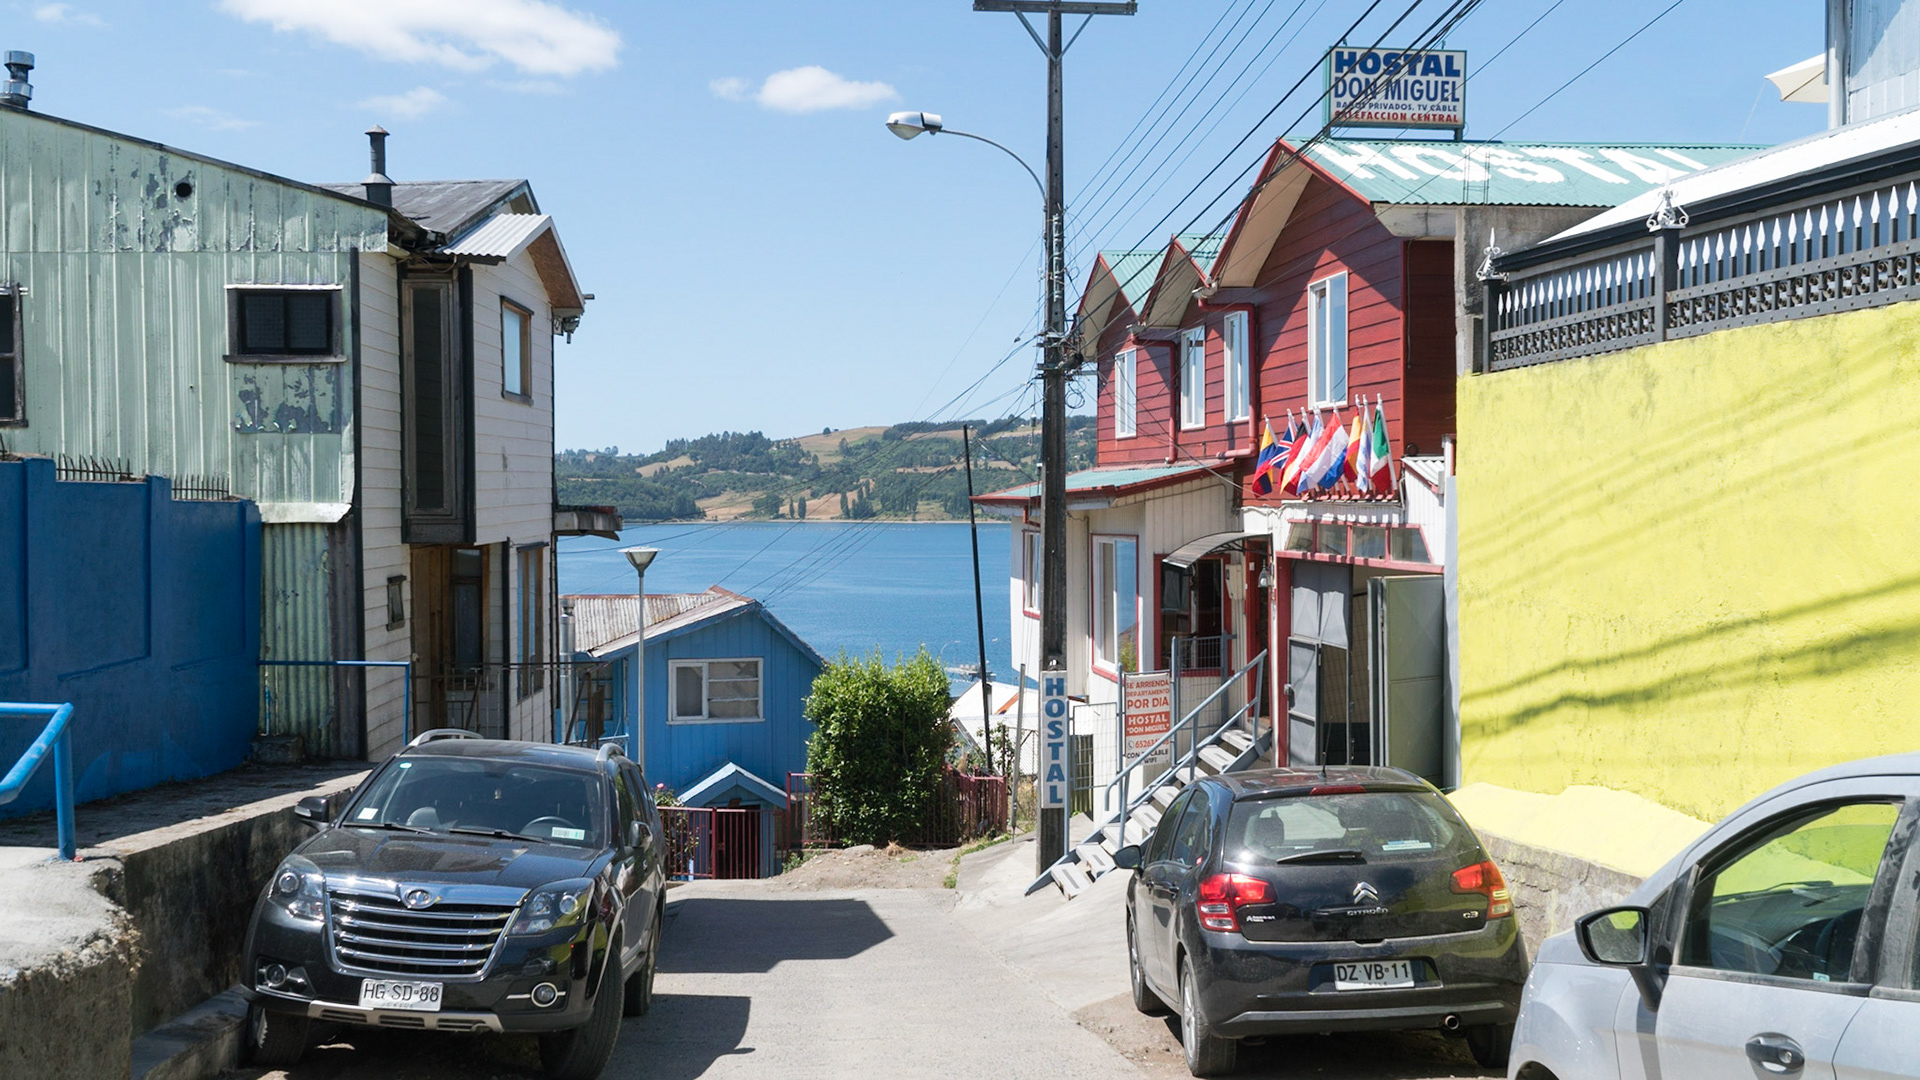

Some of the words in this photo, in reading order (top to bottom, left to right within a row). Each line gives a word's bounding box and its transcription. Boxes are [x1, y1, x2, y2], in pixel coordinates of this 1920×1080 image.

[1335, 51, 1460, 77] HOSTAL
[1334, 77, 1378, 100] DON
[1385, 79, 1460, 102] MIGUEL
[1336, 101, 1366, 110] BAOS
[1411, 113, 1458, 123] CENTRAL
[1135, 680, 1169, 688] ARRIENDA
[1127, 698, 1149, 709] POR
[1152, 696, 1169, 708] DIA
[1128, 714, 1168, 726] HOSTAL
[1045, 678, 1066, 804] HOSTAL
[1462, 910, 1479, 919] C3
